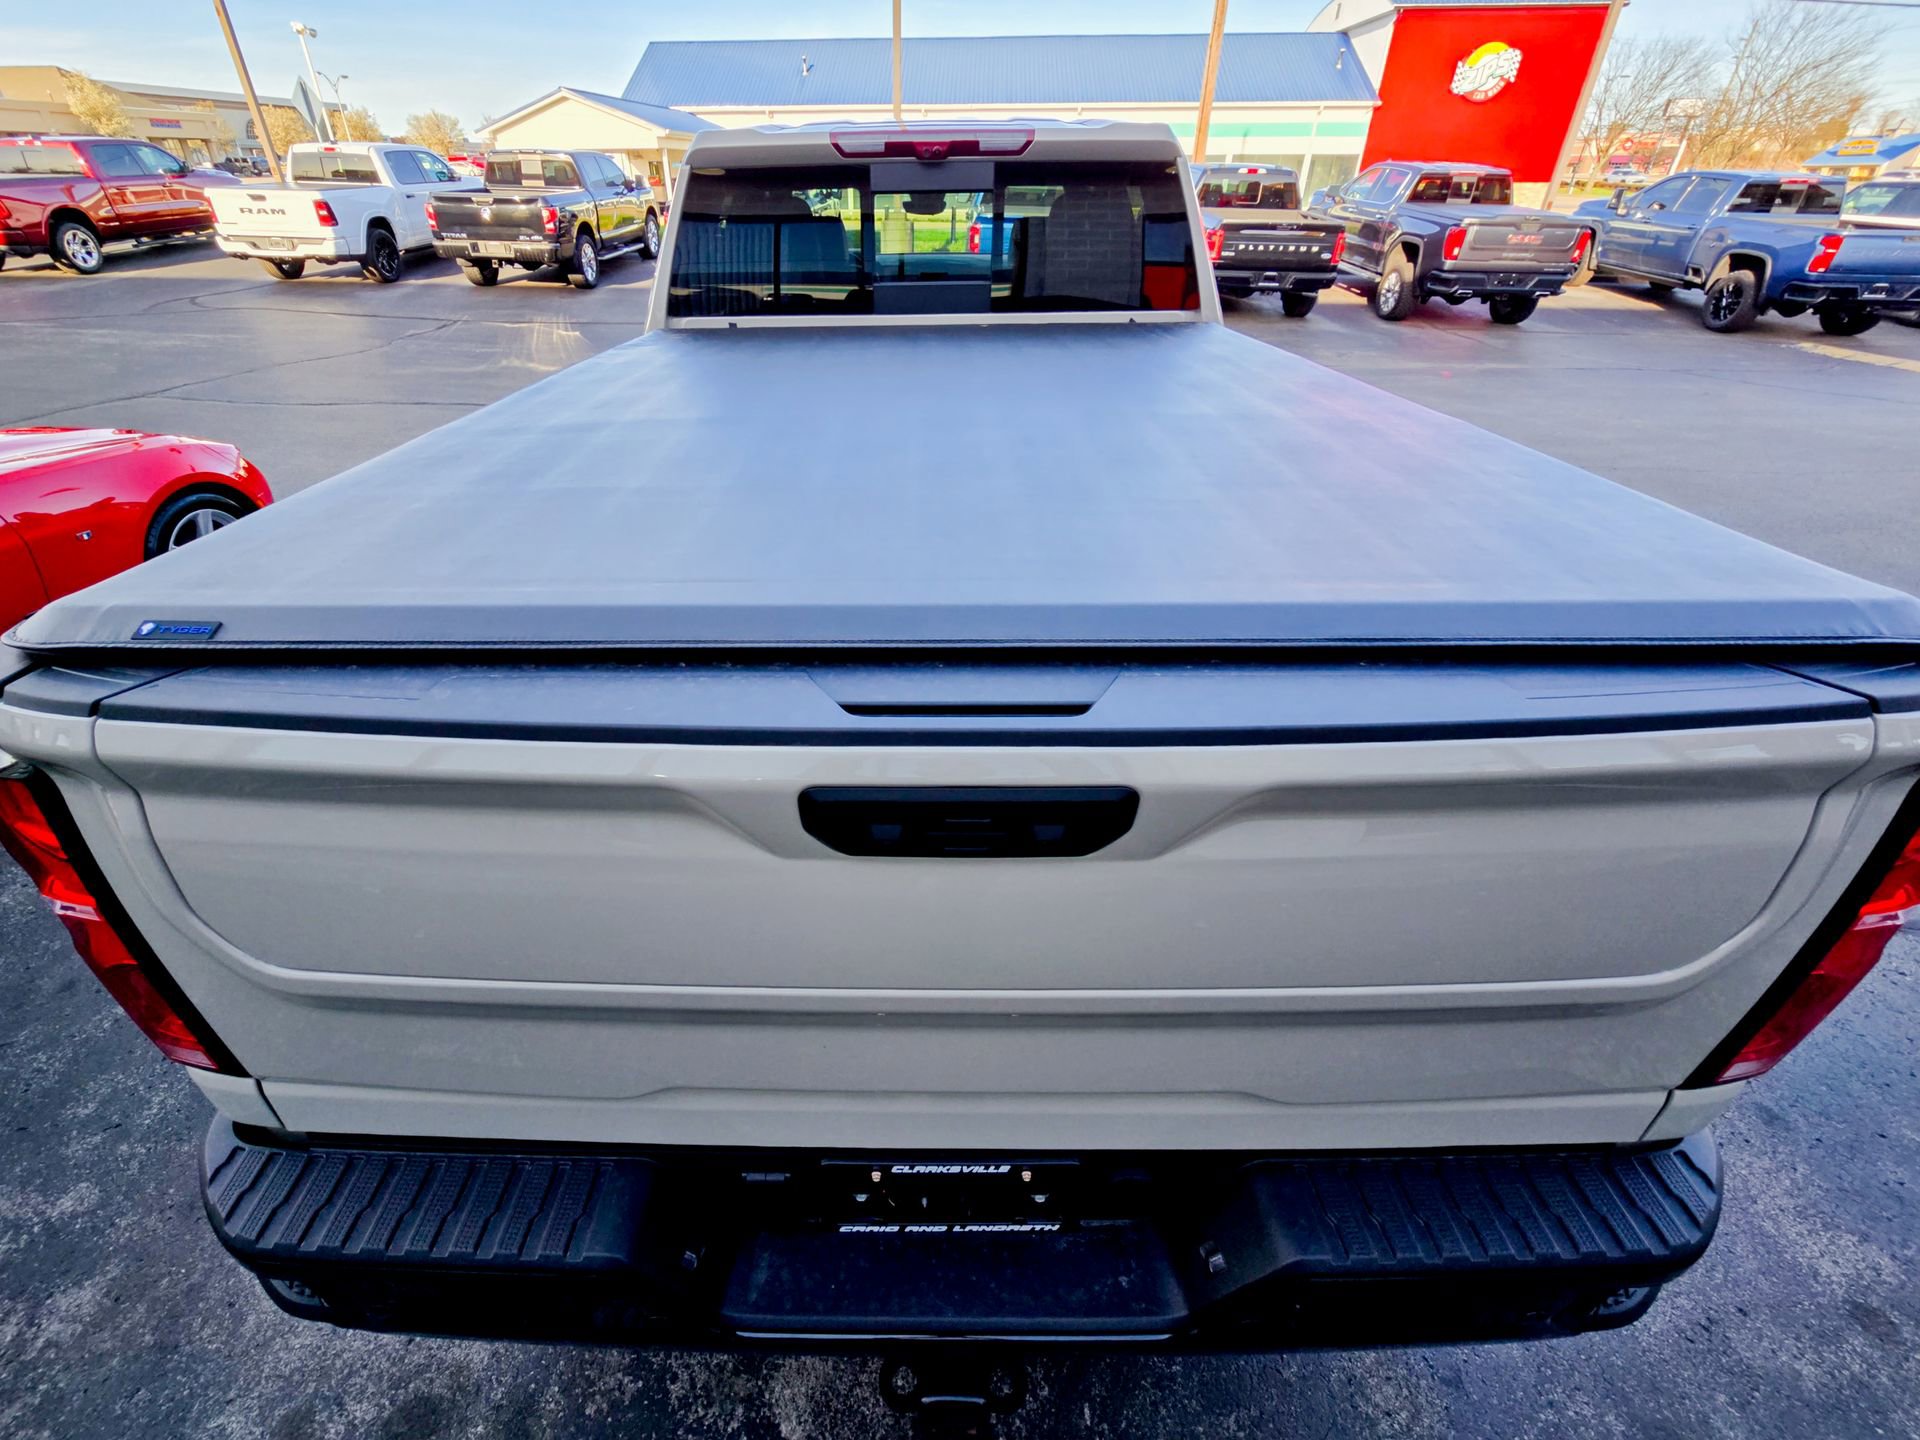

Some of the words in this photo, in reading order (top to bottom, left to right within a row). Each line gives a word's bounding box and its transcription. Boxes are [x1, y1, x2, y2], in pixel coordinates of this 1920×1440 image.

[239, 207, 286, 216] RAM
[1238, 244, 1320, 252] PLATINUM
[159, 625, 211, 634] TYGER
[891, 1165, 1011, 1173] CLARKSVILLE
